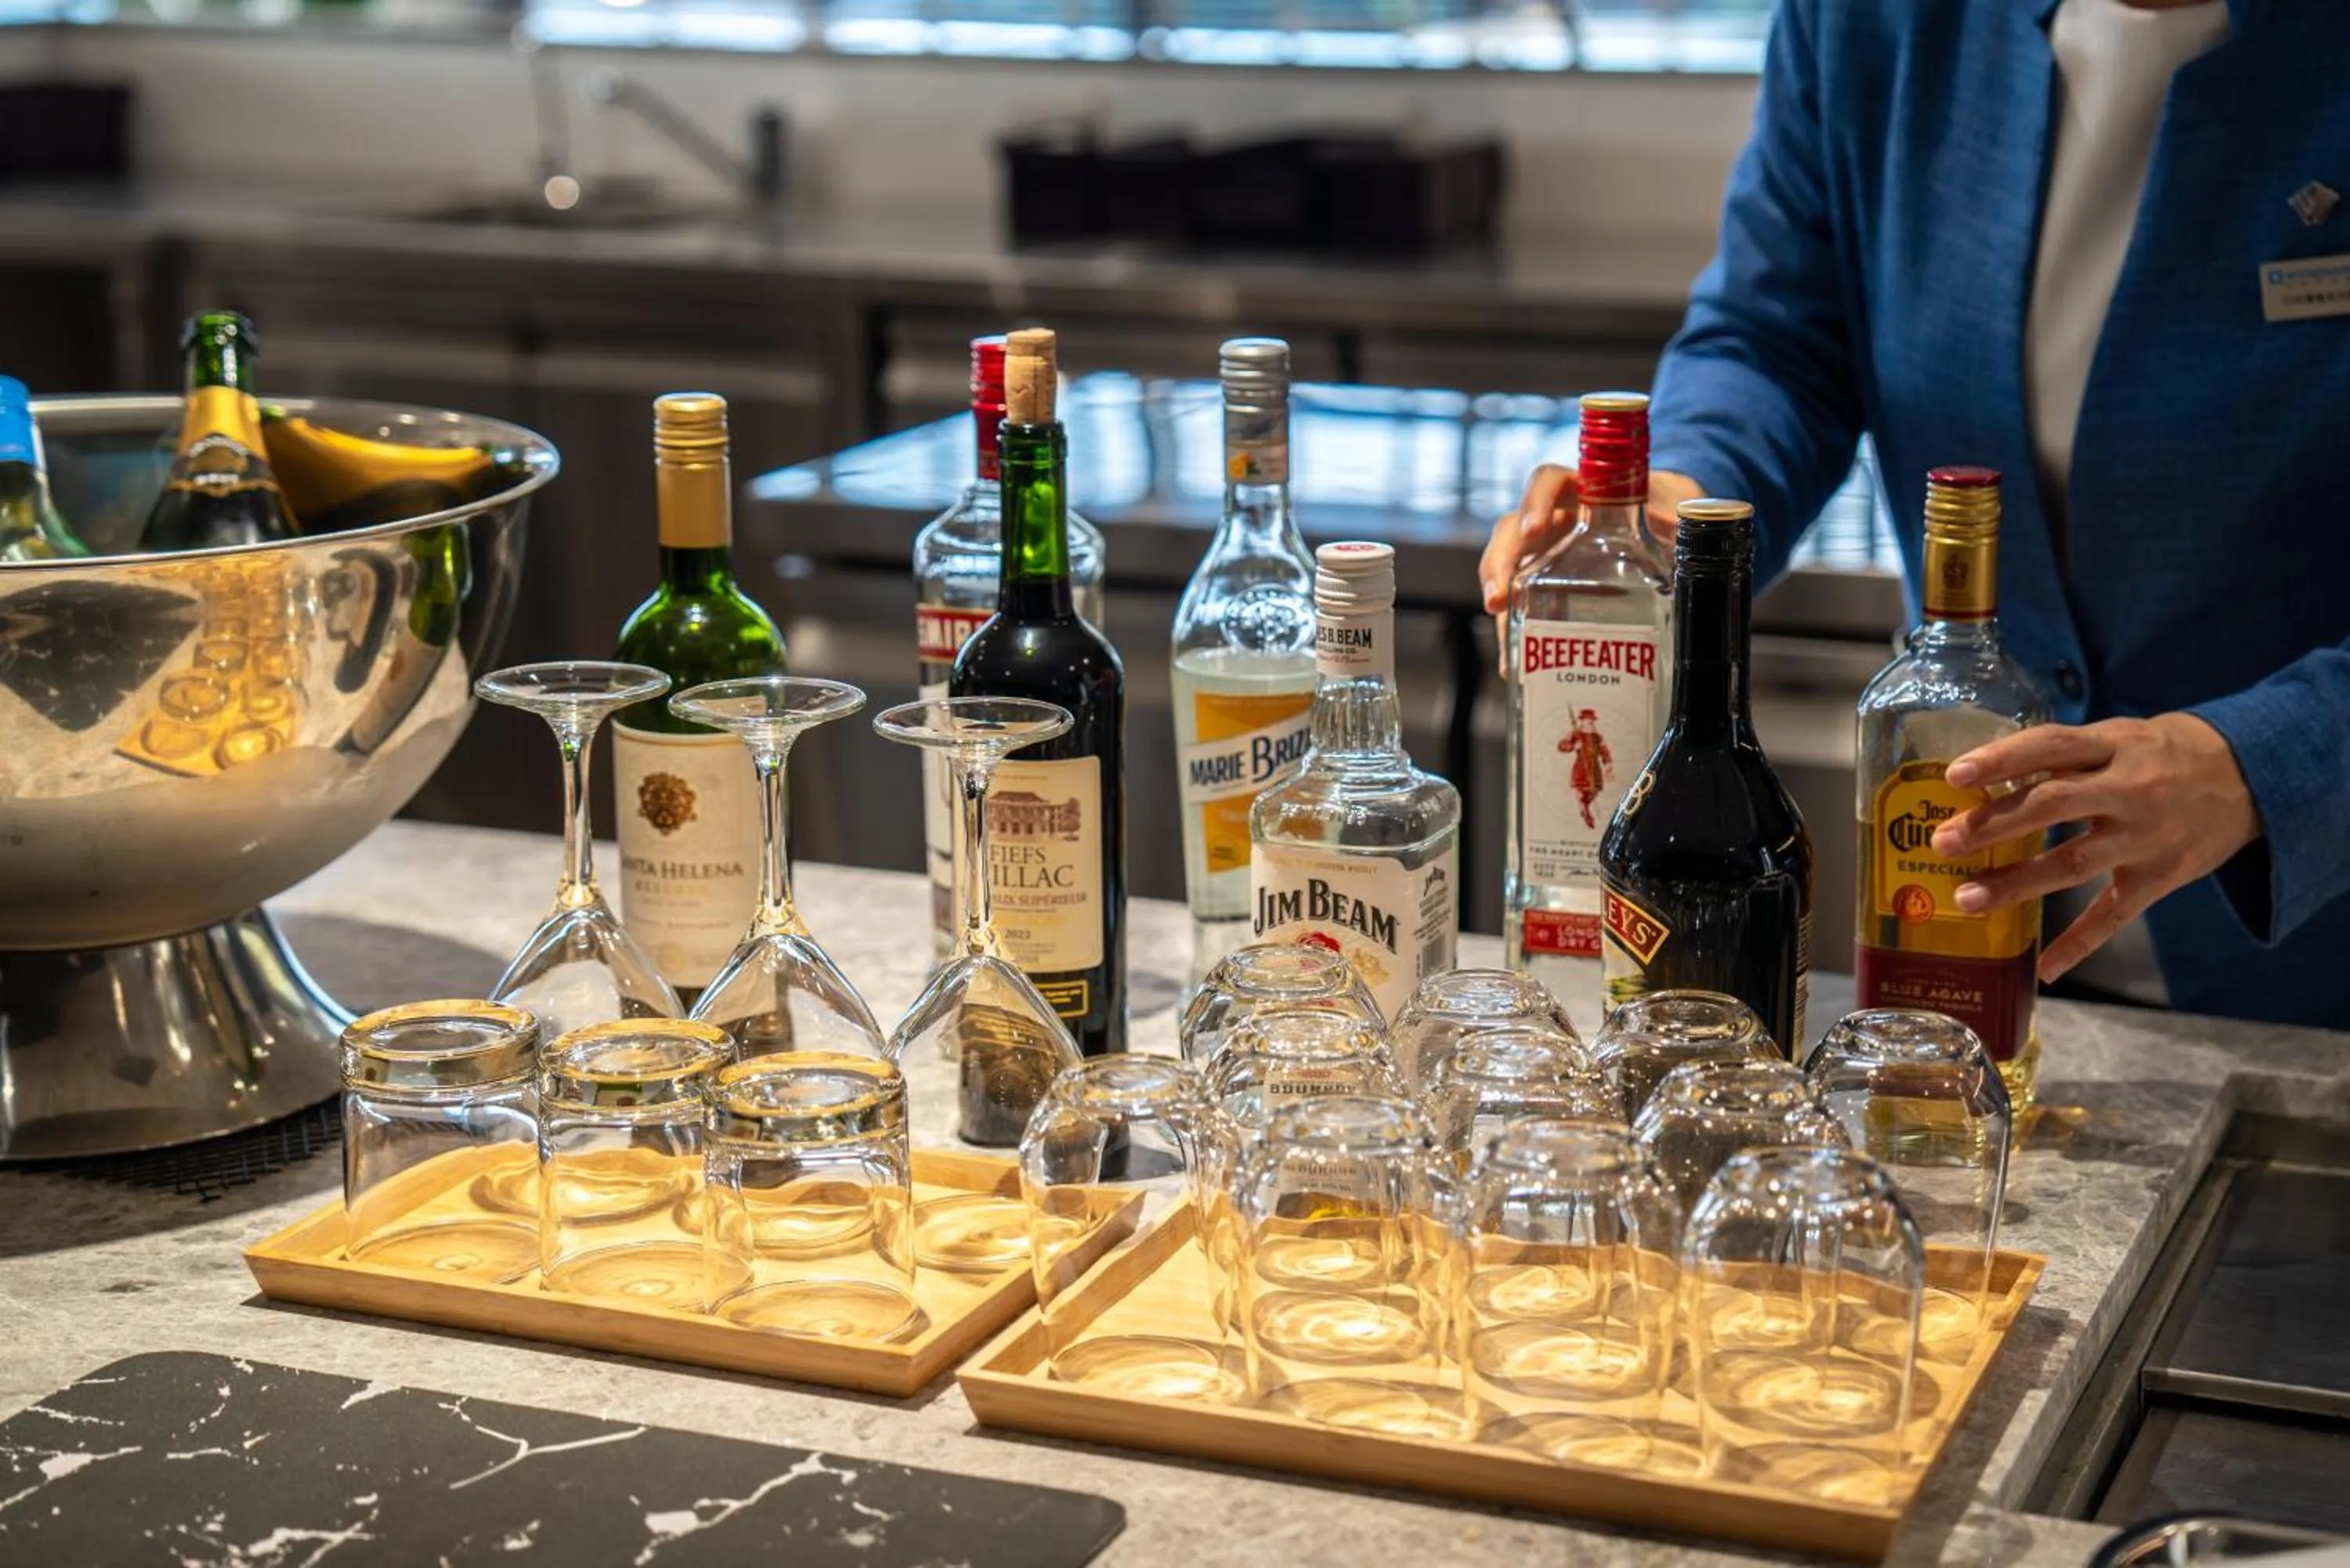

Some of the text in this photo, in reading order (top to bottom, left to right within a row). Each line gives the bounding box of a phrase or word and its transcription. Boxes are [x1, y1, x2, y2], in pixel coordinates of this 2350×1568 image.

[1337, 629, 1372, 649] BEAM
[1525, 635, 1656, 681] BEEFEATER
[1556, 672, 1621, 685] LONDON
[1190, 727, 1311, 786] MARIE BRIZ
[1888, 811, 1938, 852] Cue
[990, 844, 1046, 864] FIEFS
[662, 860, 743, 880] HELENA
[992, 864, 1074, 888] ILLAC
[1897, 860, 1975, 876] ESPECIAL
[1254, 886, 1304, 938] JIM
[1307, 878, 1397, 955] BEAM
[1608, 896, 1652, 945] EYS
[1557, 926, 1601, 939] LOND
[1880, 981, 1922, 997] BLUE
[1928, 987, 1984, 1003] AGAVE
